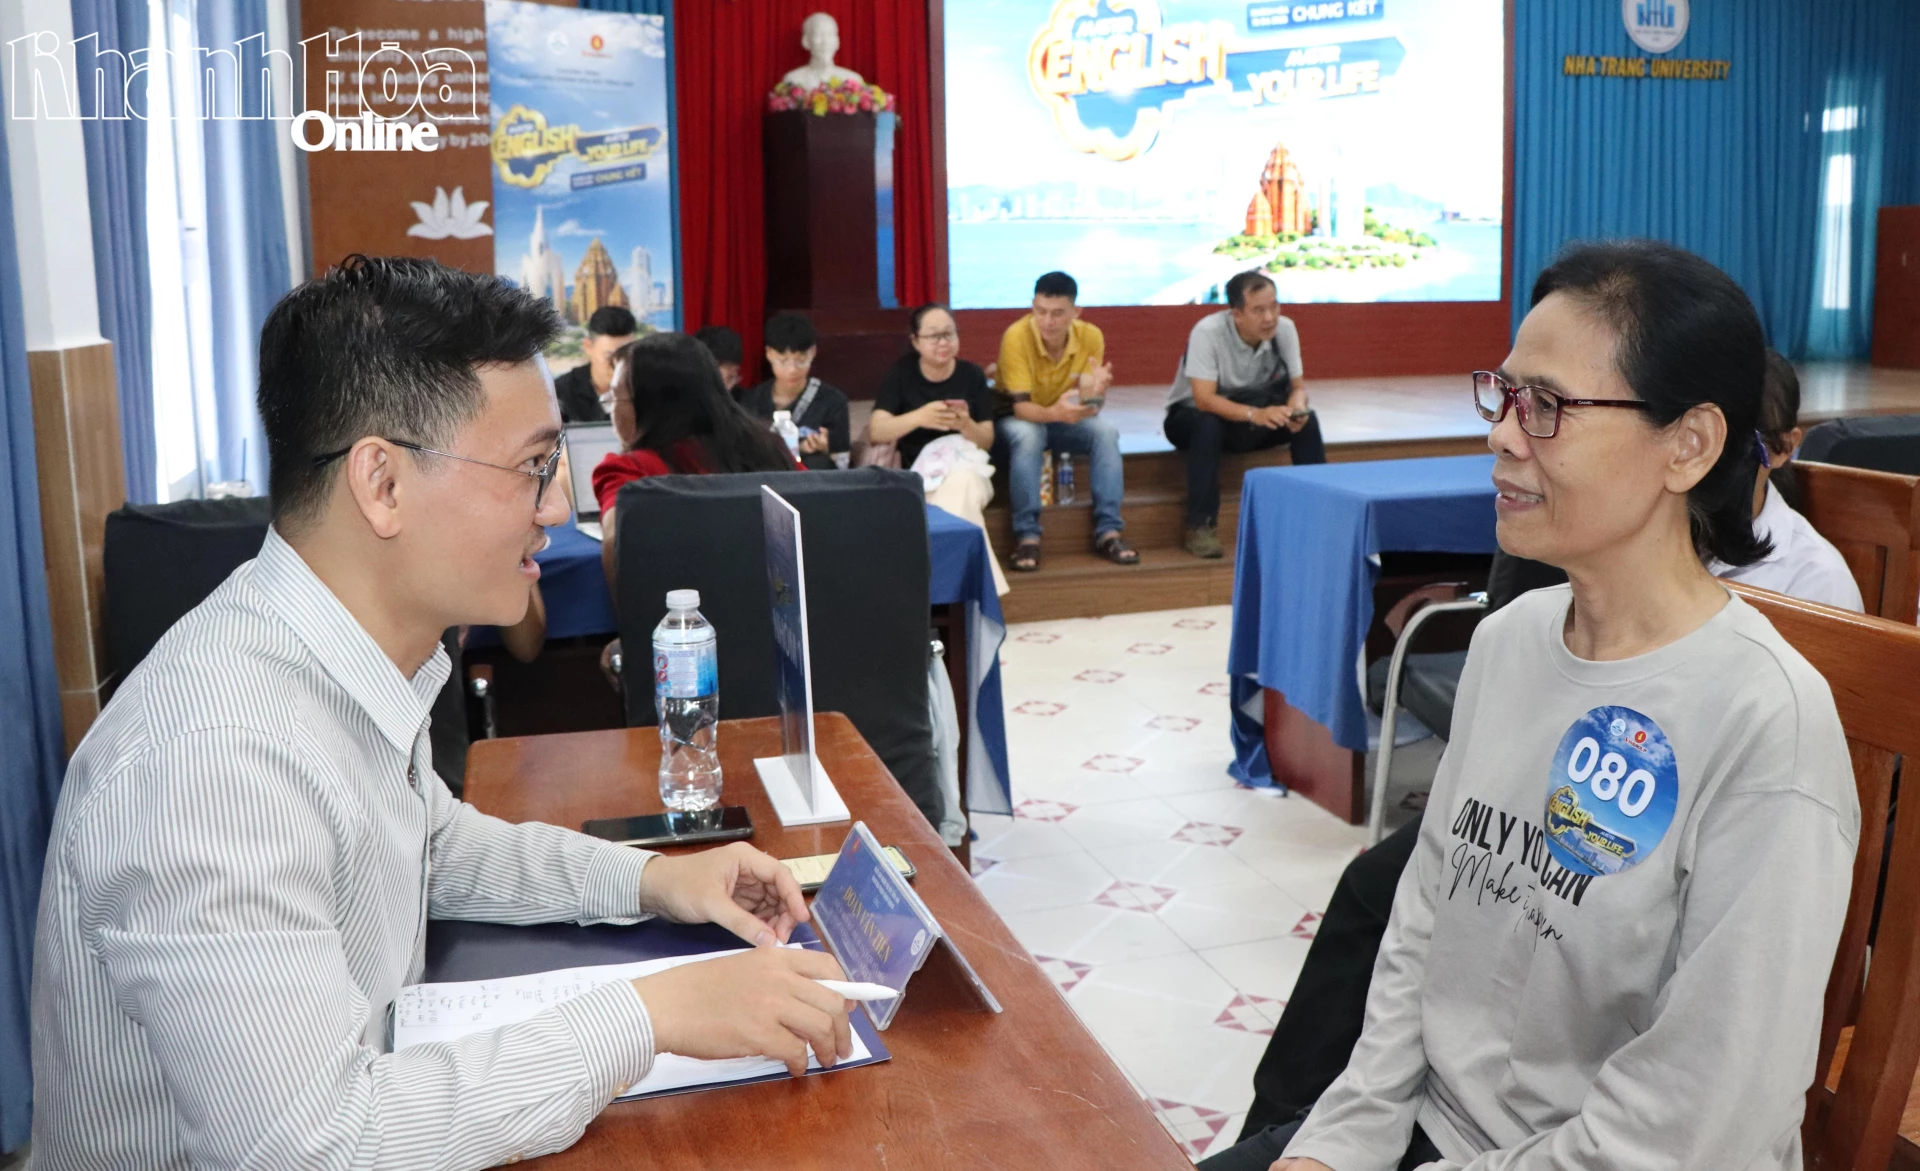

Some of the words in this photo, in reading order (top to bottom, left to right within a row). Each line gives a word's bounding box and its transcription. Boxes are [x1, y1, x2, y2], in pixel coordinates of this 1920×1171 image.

[1048, 22, 1231, 94] ENGLISH
[1564, 56, 1596, 75] NHA
[1600, 57, 1646, 77] TRANG
[1650, 59, 1731, 80] UNIVERSITY
[1246, 68, 1326, 106] YOUR
[1326, 60, 1380, 98] LIFE
[496, 126, 578, 157] ENGLISH
[1567, 736, 1656, 817] 080
[1549, 796, 1590, 827] ENGLISH
[1452, 797, 1517, 855] ONLY
[1521, 821, 1545, 873] YO
[1587, 831, 1608, 848] YOUR
[1606, 839, 1624, 857] LIFE
[1449, 843, 1521, 905] Make
